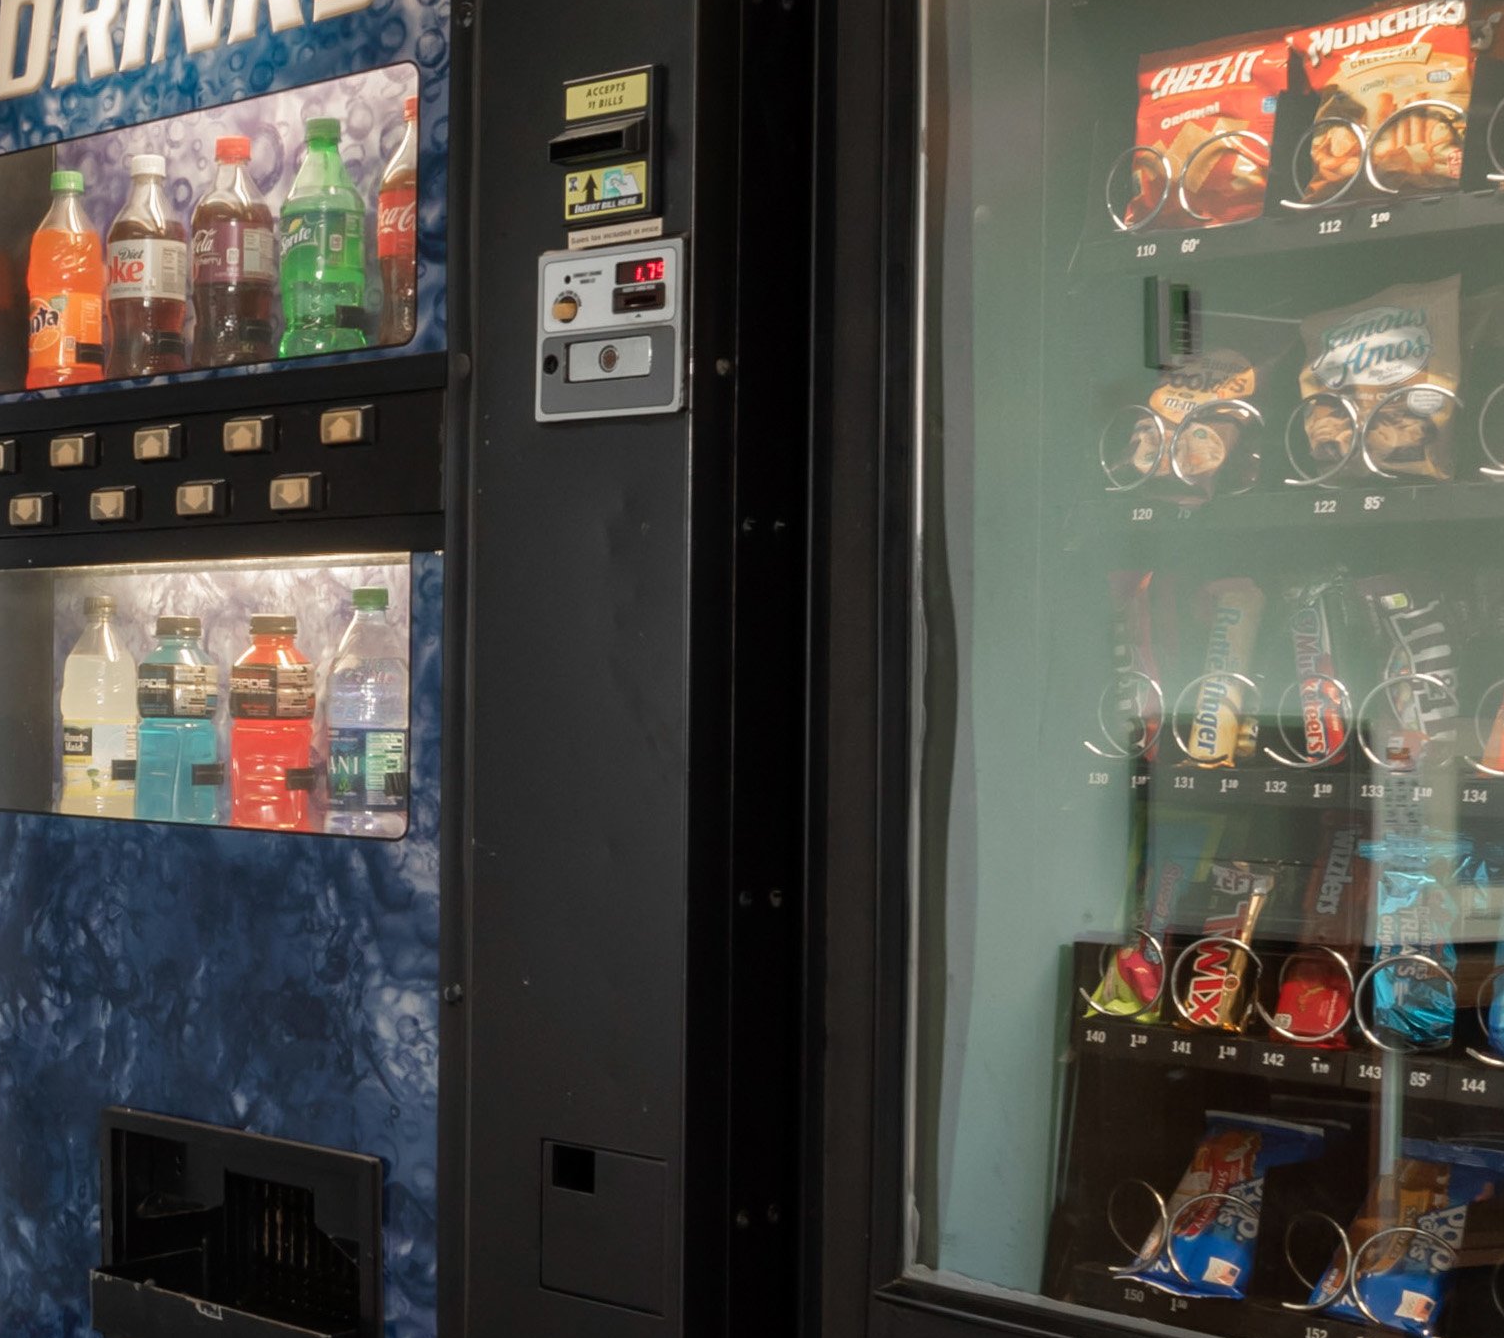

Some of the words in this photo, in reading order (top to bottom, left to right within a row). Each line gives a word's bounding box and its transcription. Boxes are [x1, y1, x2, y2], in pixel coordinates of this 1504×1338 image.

[586, 81, 626, 98] ACCEPTS
[599, 95, 624, 108] BILLS
[574, 200, 601, 214] INSERT
[601, 197, 617, 210] BILL
[618, 195, 638, 206] HERE
[1318, 219, 1341, 234] 112
[119, 248, 144, 260] Diet
[1136, 243, 1157, 257] 110
[1340, 336, 1435, 380] Amos
[1313, 499, 1337, 514] 122
[1131, 508, 1154, 520] 120
[1197, 608, 1242, 755] Butterfinger
[1088, 772, 1109, 785] 130
[1174, 776, 1195, 789] 131
[1265, 781, 1287, 794] 132
[1361, 785, 1385, 798] 133
[1462, 789, 1488, 803] 134
[1086, 1030, 1106, 1044] 140
[1172, 1041, 1191, 1055] 141
[1262, 1053, 1285, 1068] 142
[1358, 1065, 1382, 1079] 143
[1461, 1079, 1487, 1093] 144
[1123, 1288, 1145, 1303] 150
